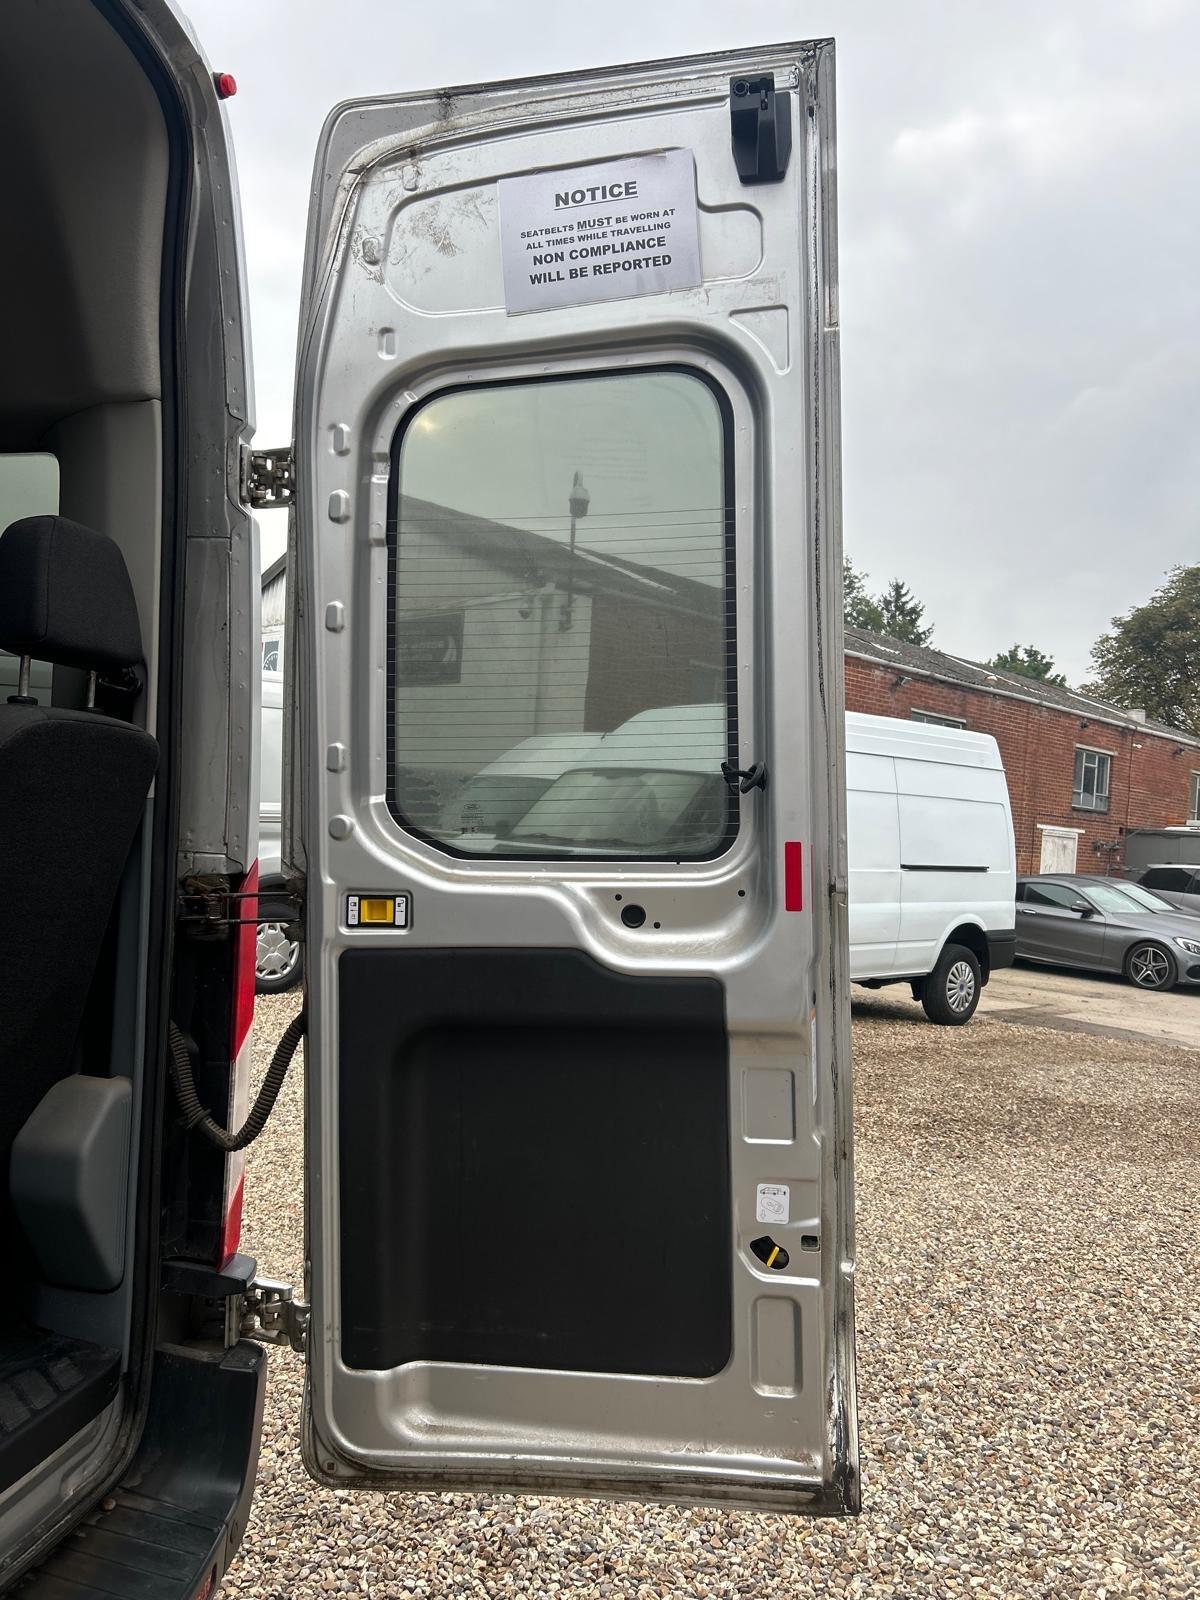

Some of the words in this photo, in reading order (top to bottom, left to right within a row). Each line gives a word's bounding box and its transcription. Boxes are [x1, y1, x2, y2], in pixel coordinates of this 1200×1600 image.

[555, 181, 638, 208] NOTICE
[521, 224, 574, 239] SEATBELTS
[577, 217, 612, 230] MUST
[616, 216, 628, 224] BE
[630, 211, 659, 221] WORN
[526, 241, 543, 250] ALL
[546, 237, 574, 247] TIMES
[578, 232, 607, 242] WHILE
[610, 222, 671, 237] TRAVELLING
[533, 252, 564, 265] NON
[569, 236, 666, 260] COMPLIANCE
[530, 272, 564, 284] WILL
[570, 267, 588, 279] BE
[593, 255, 672, 276] REPORTED
